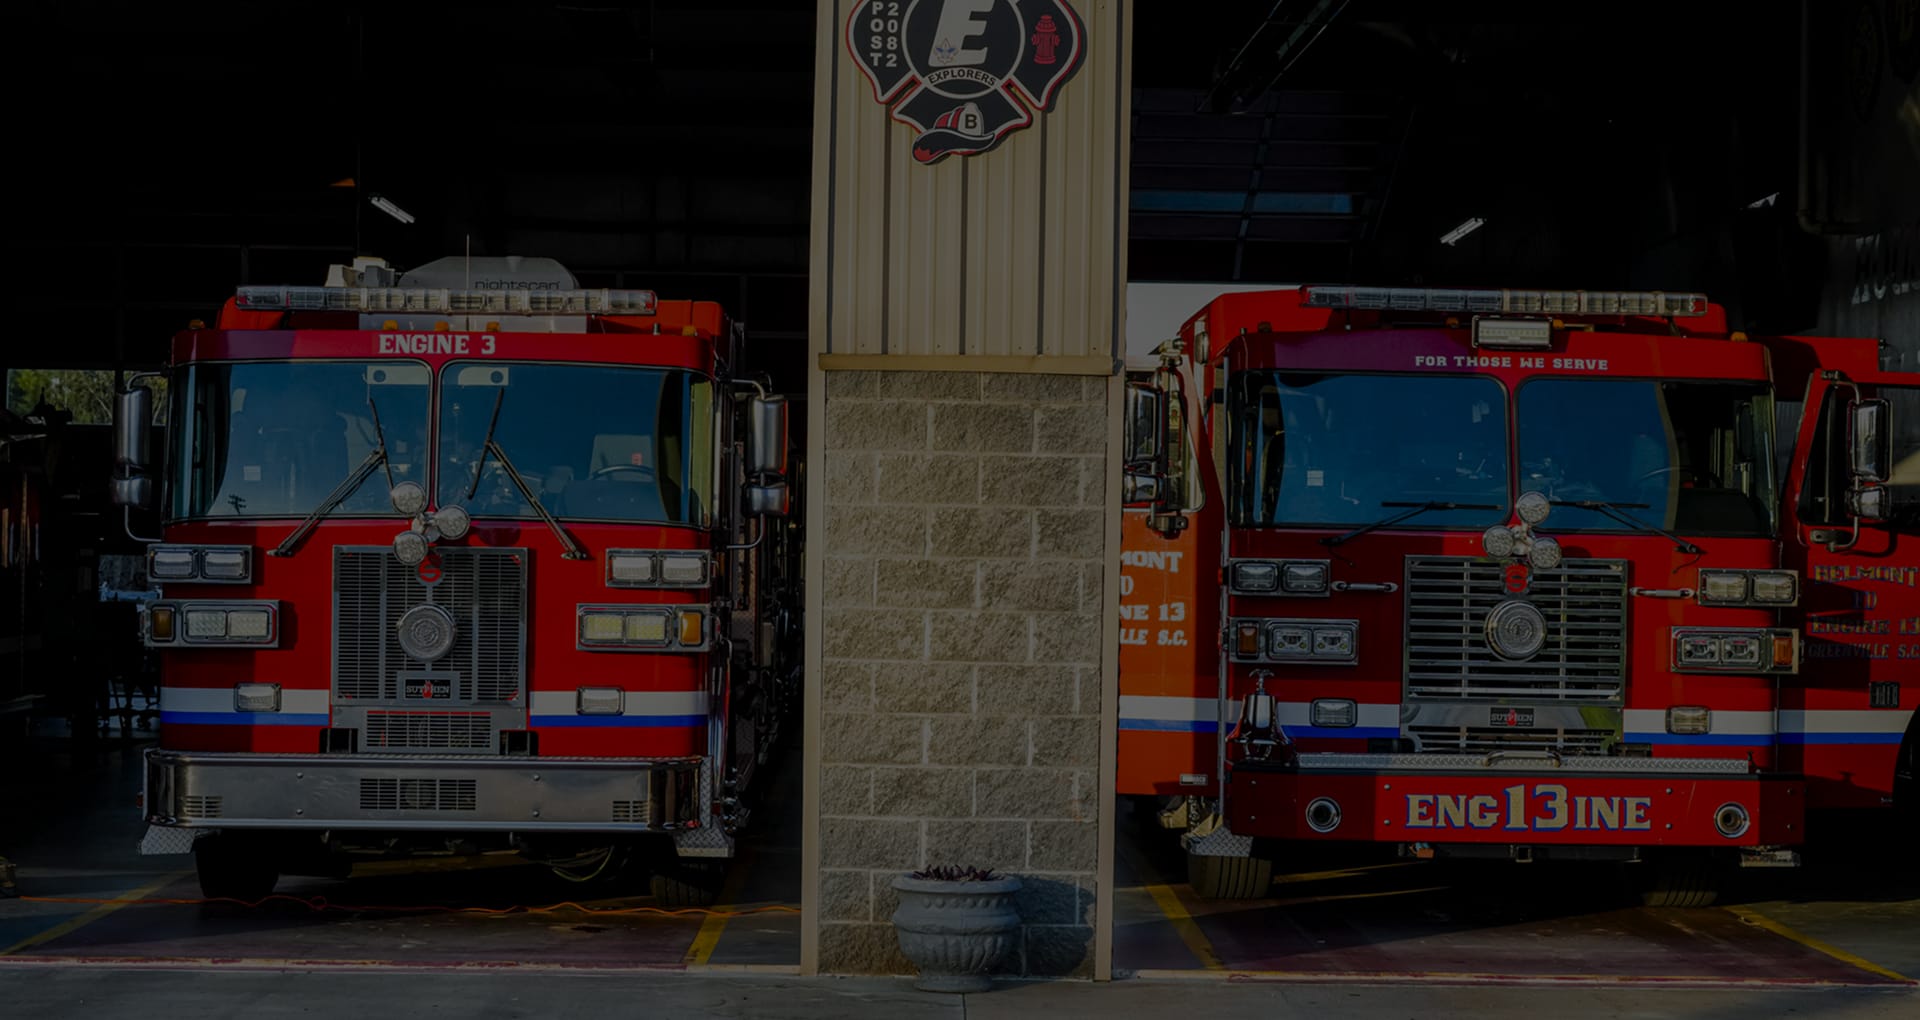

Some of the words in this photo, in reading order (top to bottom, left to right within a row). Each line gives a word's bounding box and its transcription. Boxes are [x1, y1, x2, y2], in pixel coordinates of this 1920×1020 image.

[870, 1, 884, 67] POST
[885, 1, 899, 67] 2082
[928, 68, 996, 86] EXPLORERS
[965, 115, 977, 129] B
[475, 278, 560, 290] nightscan
[378, 334, 470, 355] ENGINE
[481, 335, 497, 355] 3
[1415, 355, 1448, 367] FOR
[1453, 355, 1512, 368] THOSE
[1519, 357, 1545, 369] WE
[1552, 358, 1609, 371] SERVE
[1814, 565, 1918, 588] BELMONT
[1158, 601, 1185, 622] 13
[1810, 616, 1891, 635] ENGINE
[1808, 643, 1890, 660] GREENVILLE
